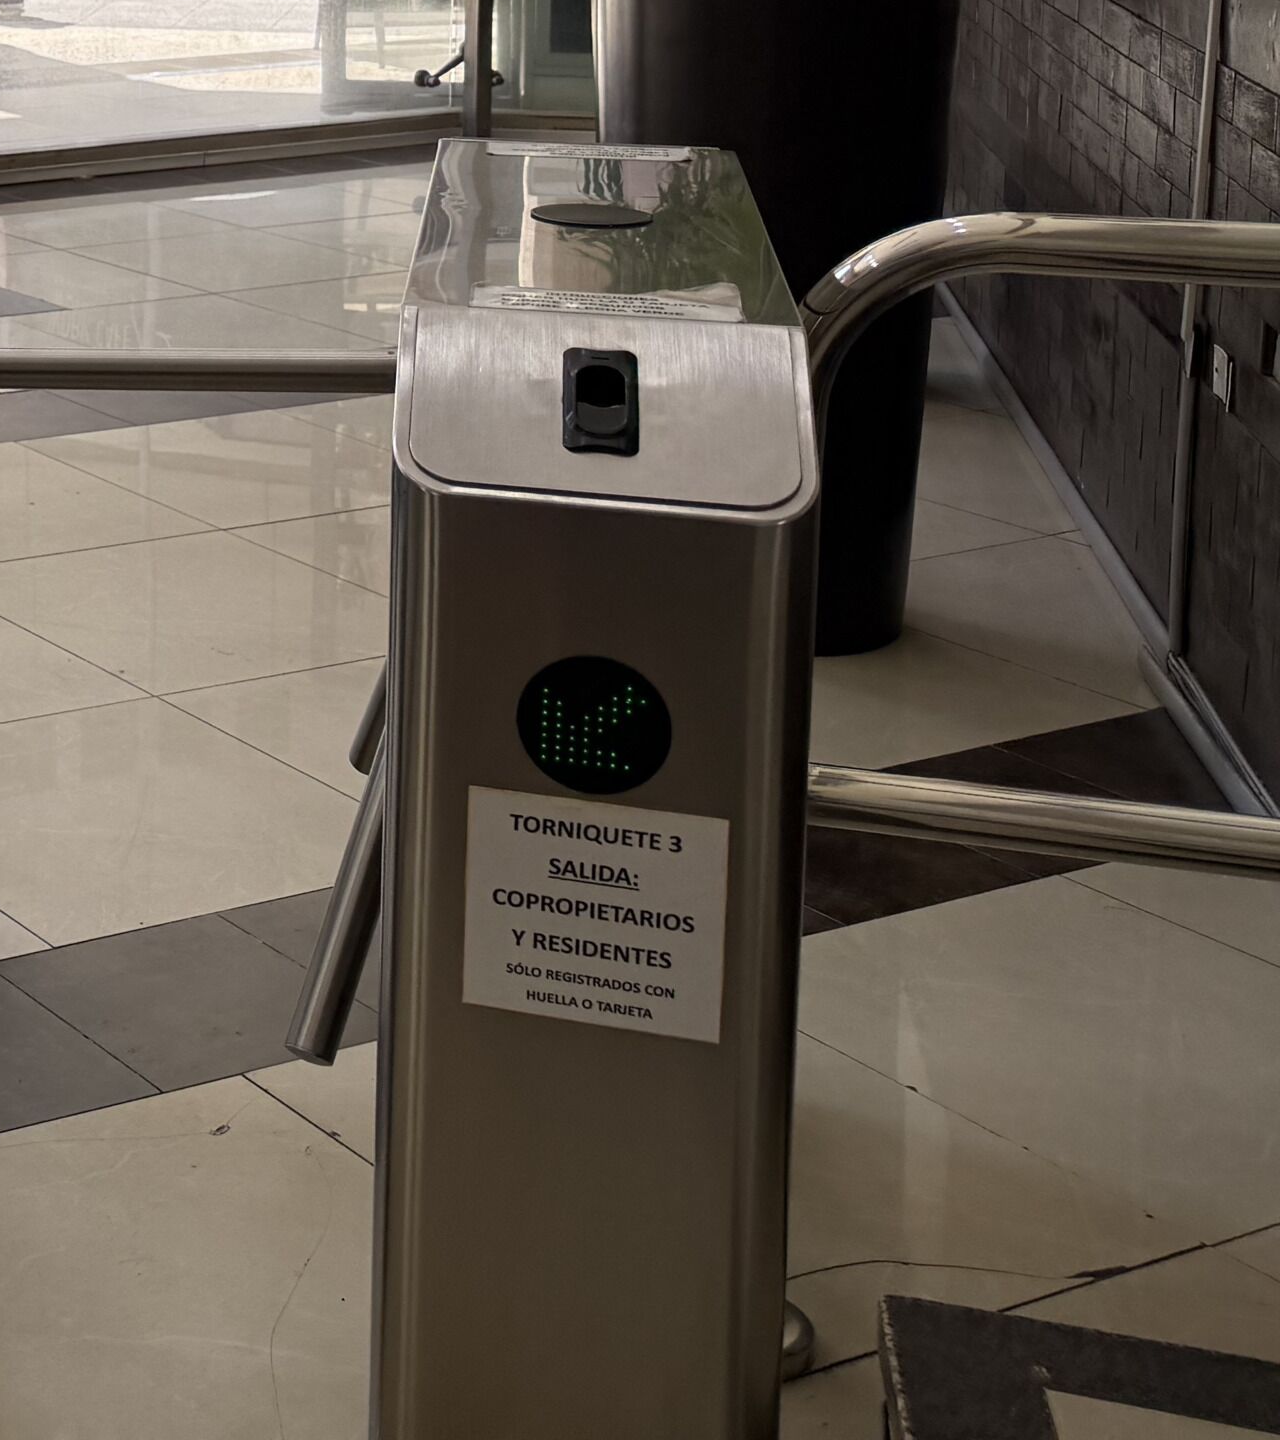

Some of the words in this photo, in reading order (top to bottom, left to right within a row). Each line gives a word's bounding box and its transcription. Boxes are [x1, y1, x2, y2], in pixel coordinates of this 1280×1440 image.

[510, 813, 661, 851] TORNIQUETE
[669, 835, 683, 853] 3
[548, 858, 640, 888] SALIDA:
[492, 888, 696, 934] COPROPIETARIOS
[512, 928, 526, 947] Y
[533, 932, 672, 970] RESIDENTES
[506, 962, 542, 978] SÓLO
[546, 968, 641, 994] REGISTRADOS
[645, 984, 675, 999] CON
[526, 989, 578, 1008] HUELLA
[582, 998, 593, 1009] O
[596, 1000, 653, 1020] TARJETA
